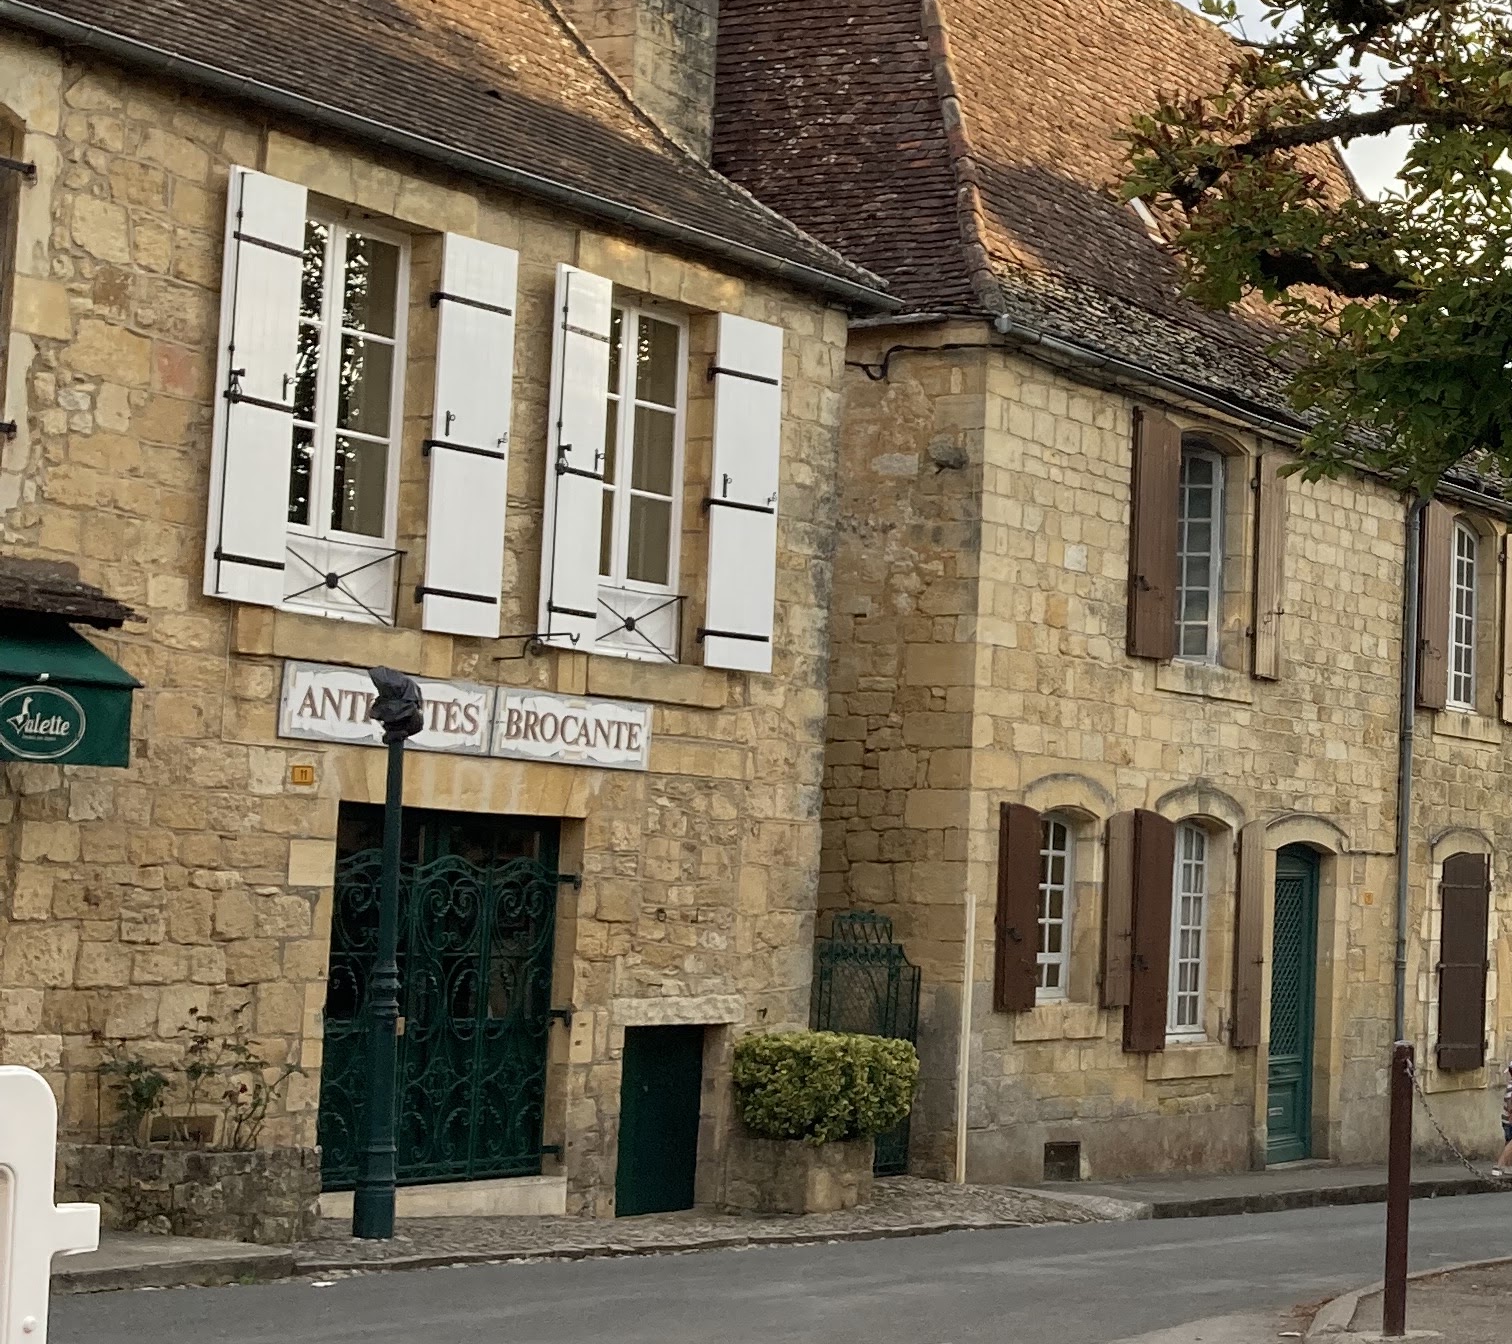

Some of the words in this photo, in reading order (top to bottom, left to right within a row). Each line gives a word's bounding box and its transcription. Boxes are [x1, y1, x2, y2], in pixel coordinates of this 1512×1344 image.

[6, 710, 71, 736] Valette
[297, 684, 480, 736] ANTITÉS
[504, 708, 642, 752] BROCANTE
